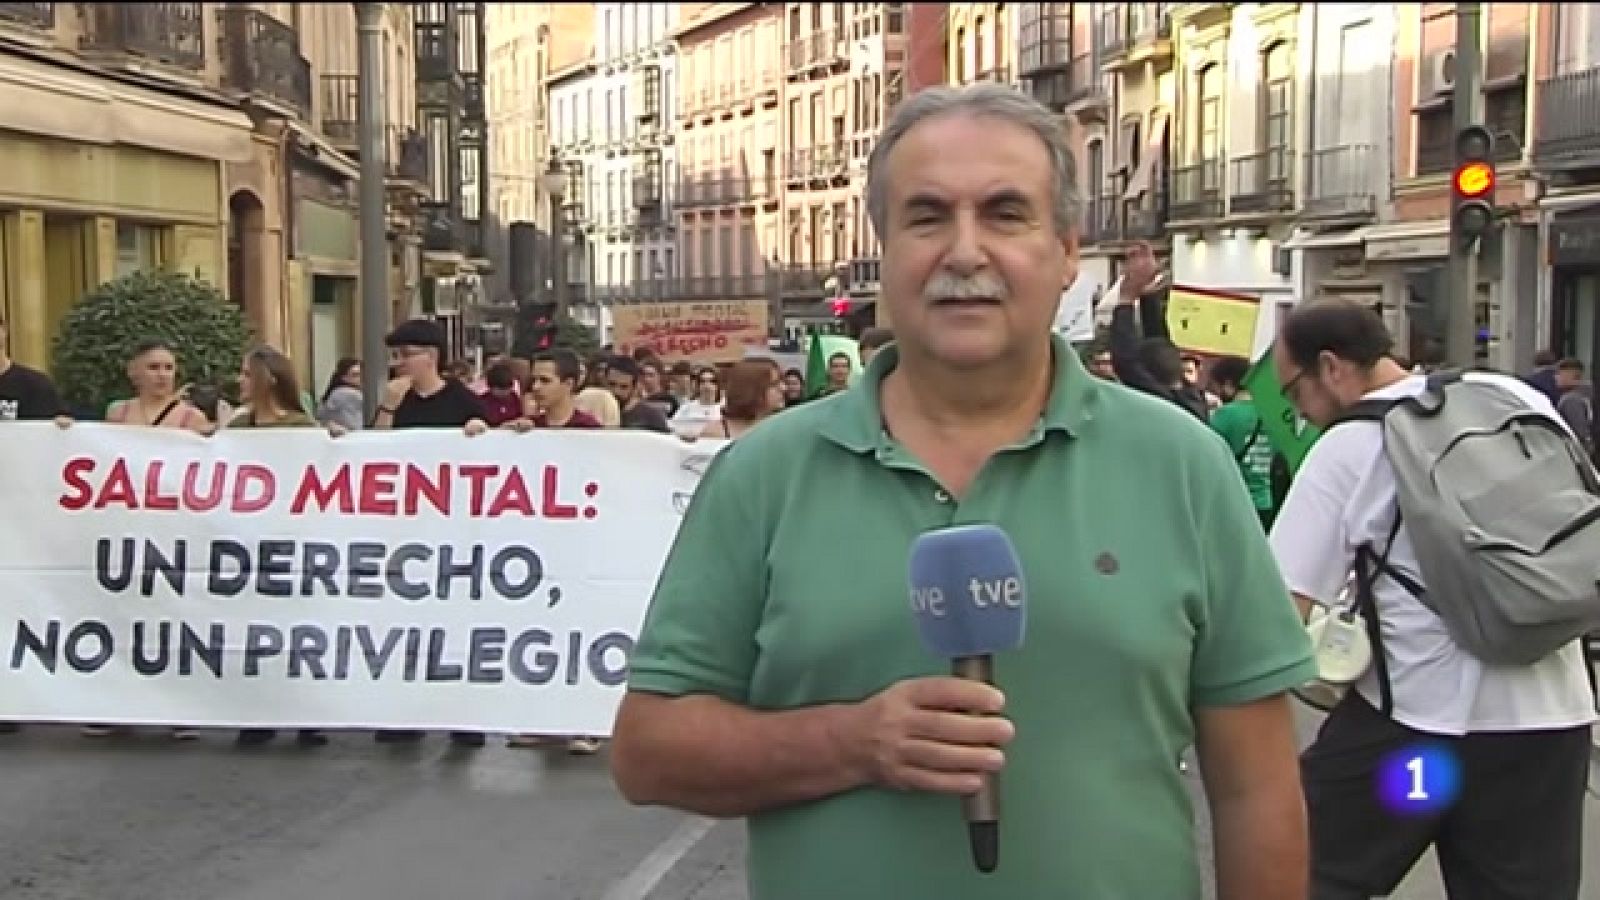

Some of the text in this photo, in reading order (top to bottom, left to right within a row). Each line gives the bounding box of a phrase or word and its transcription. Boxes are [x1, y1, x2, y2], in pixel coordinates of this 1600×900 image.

[59, 457, 599, 519] SALUD MENTAL:
[96, 537, 561, 608] UN DERECHO,
[969, 577, 1021, 607] tve
[11, 619, 632, 687] NO UN PRIVILEGIO
